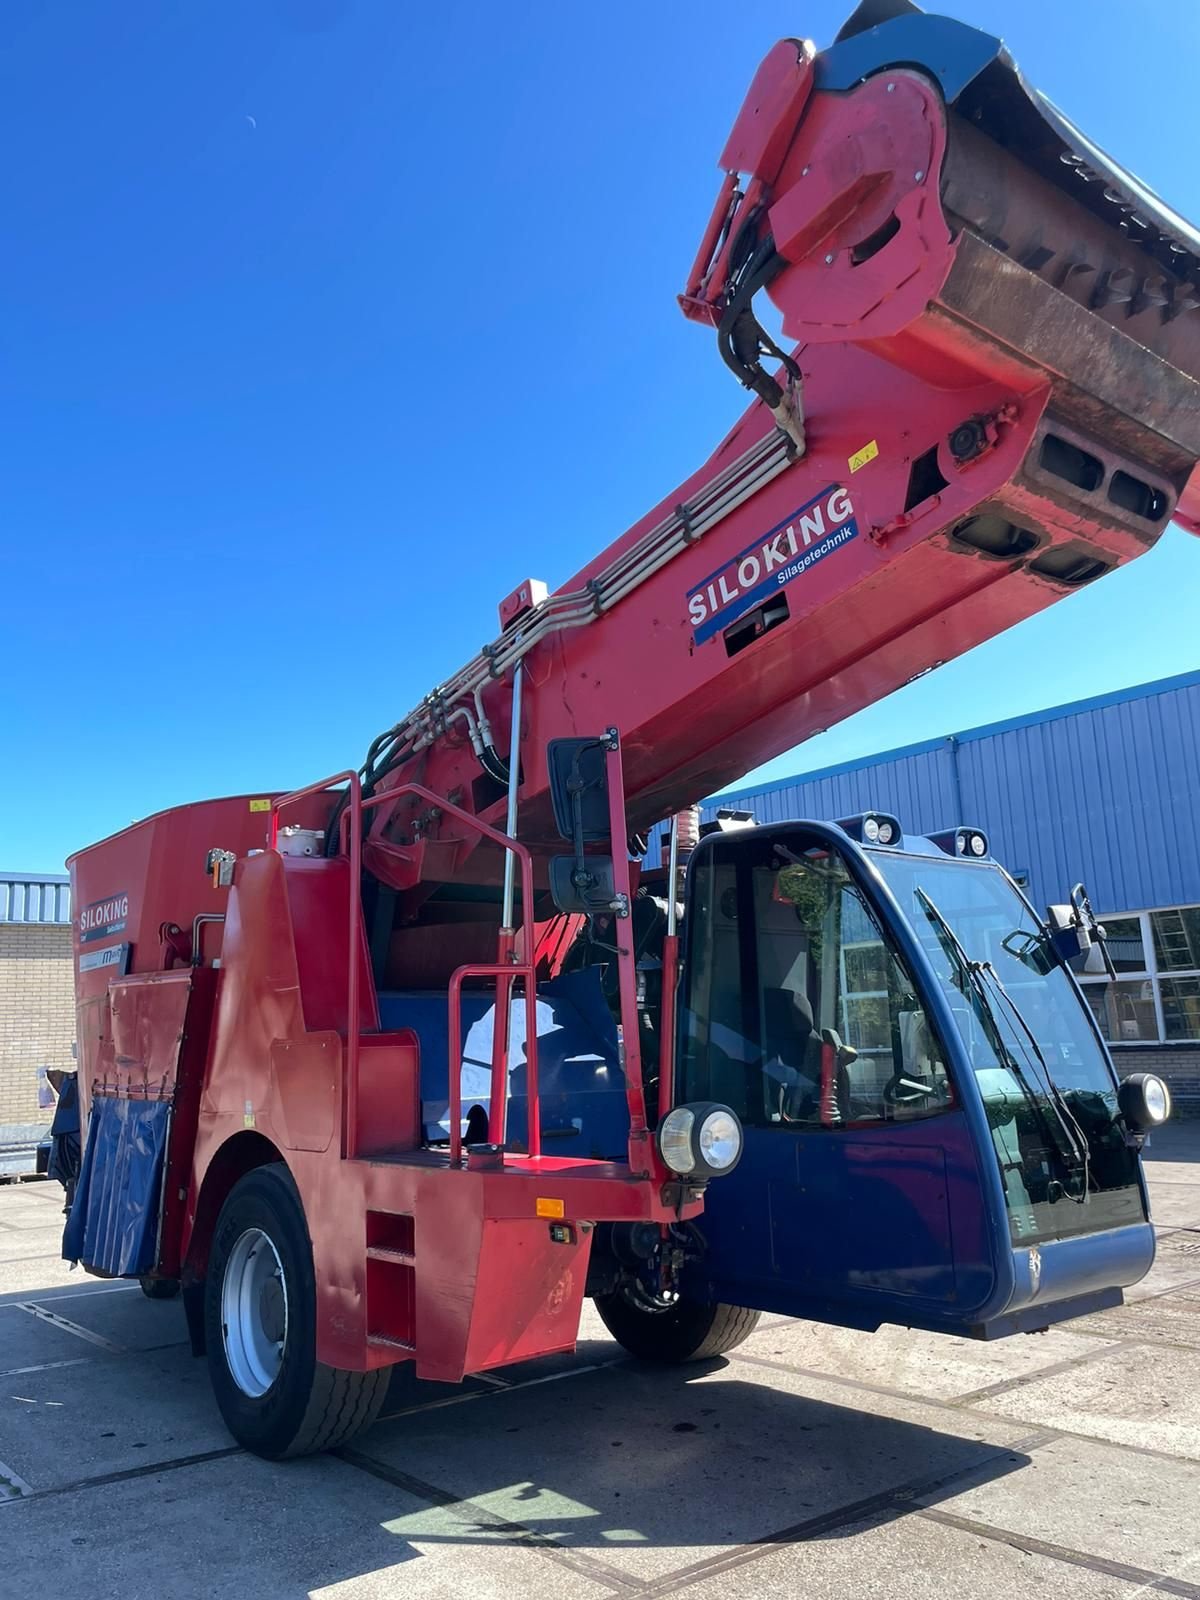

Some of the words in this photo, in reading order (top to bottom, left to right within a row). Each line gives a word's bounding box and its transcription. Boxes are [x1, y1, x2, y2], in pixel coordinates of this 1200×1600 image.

[688, 487, 854, 625] SILOKING
[777, 526, 853, 584] Silagetechnik
[80, 896, 128, 930] SILOKING
